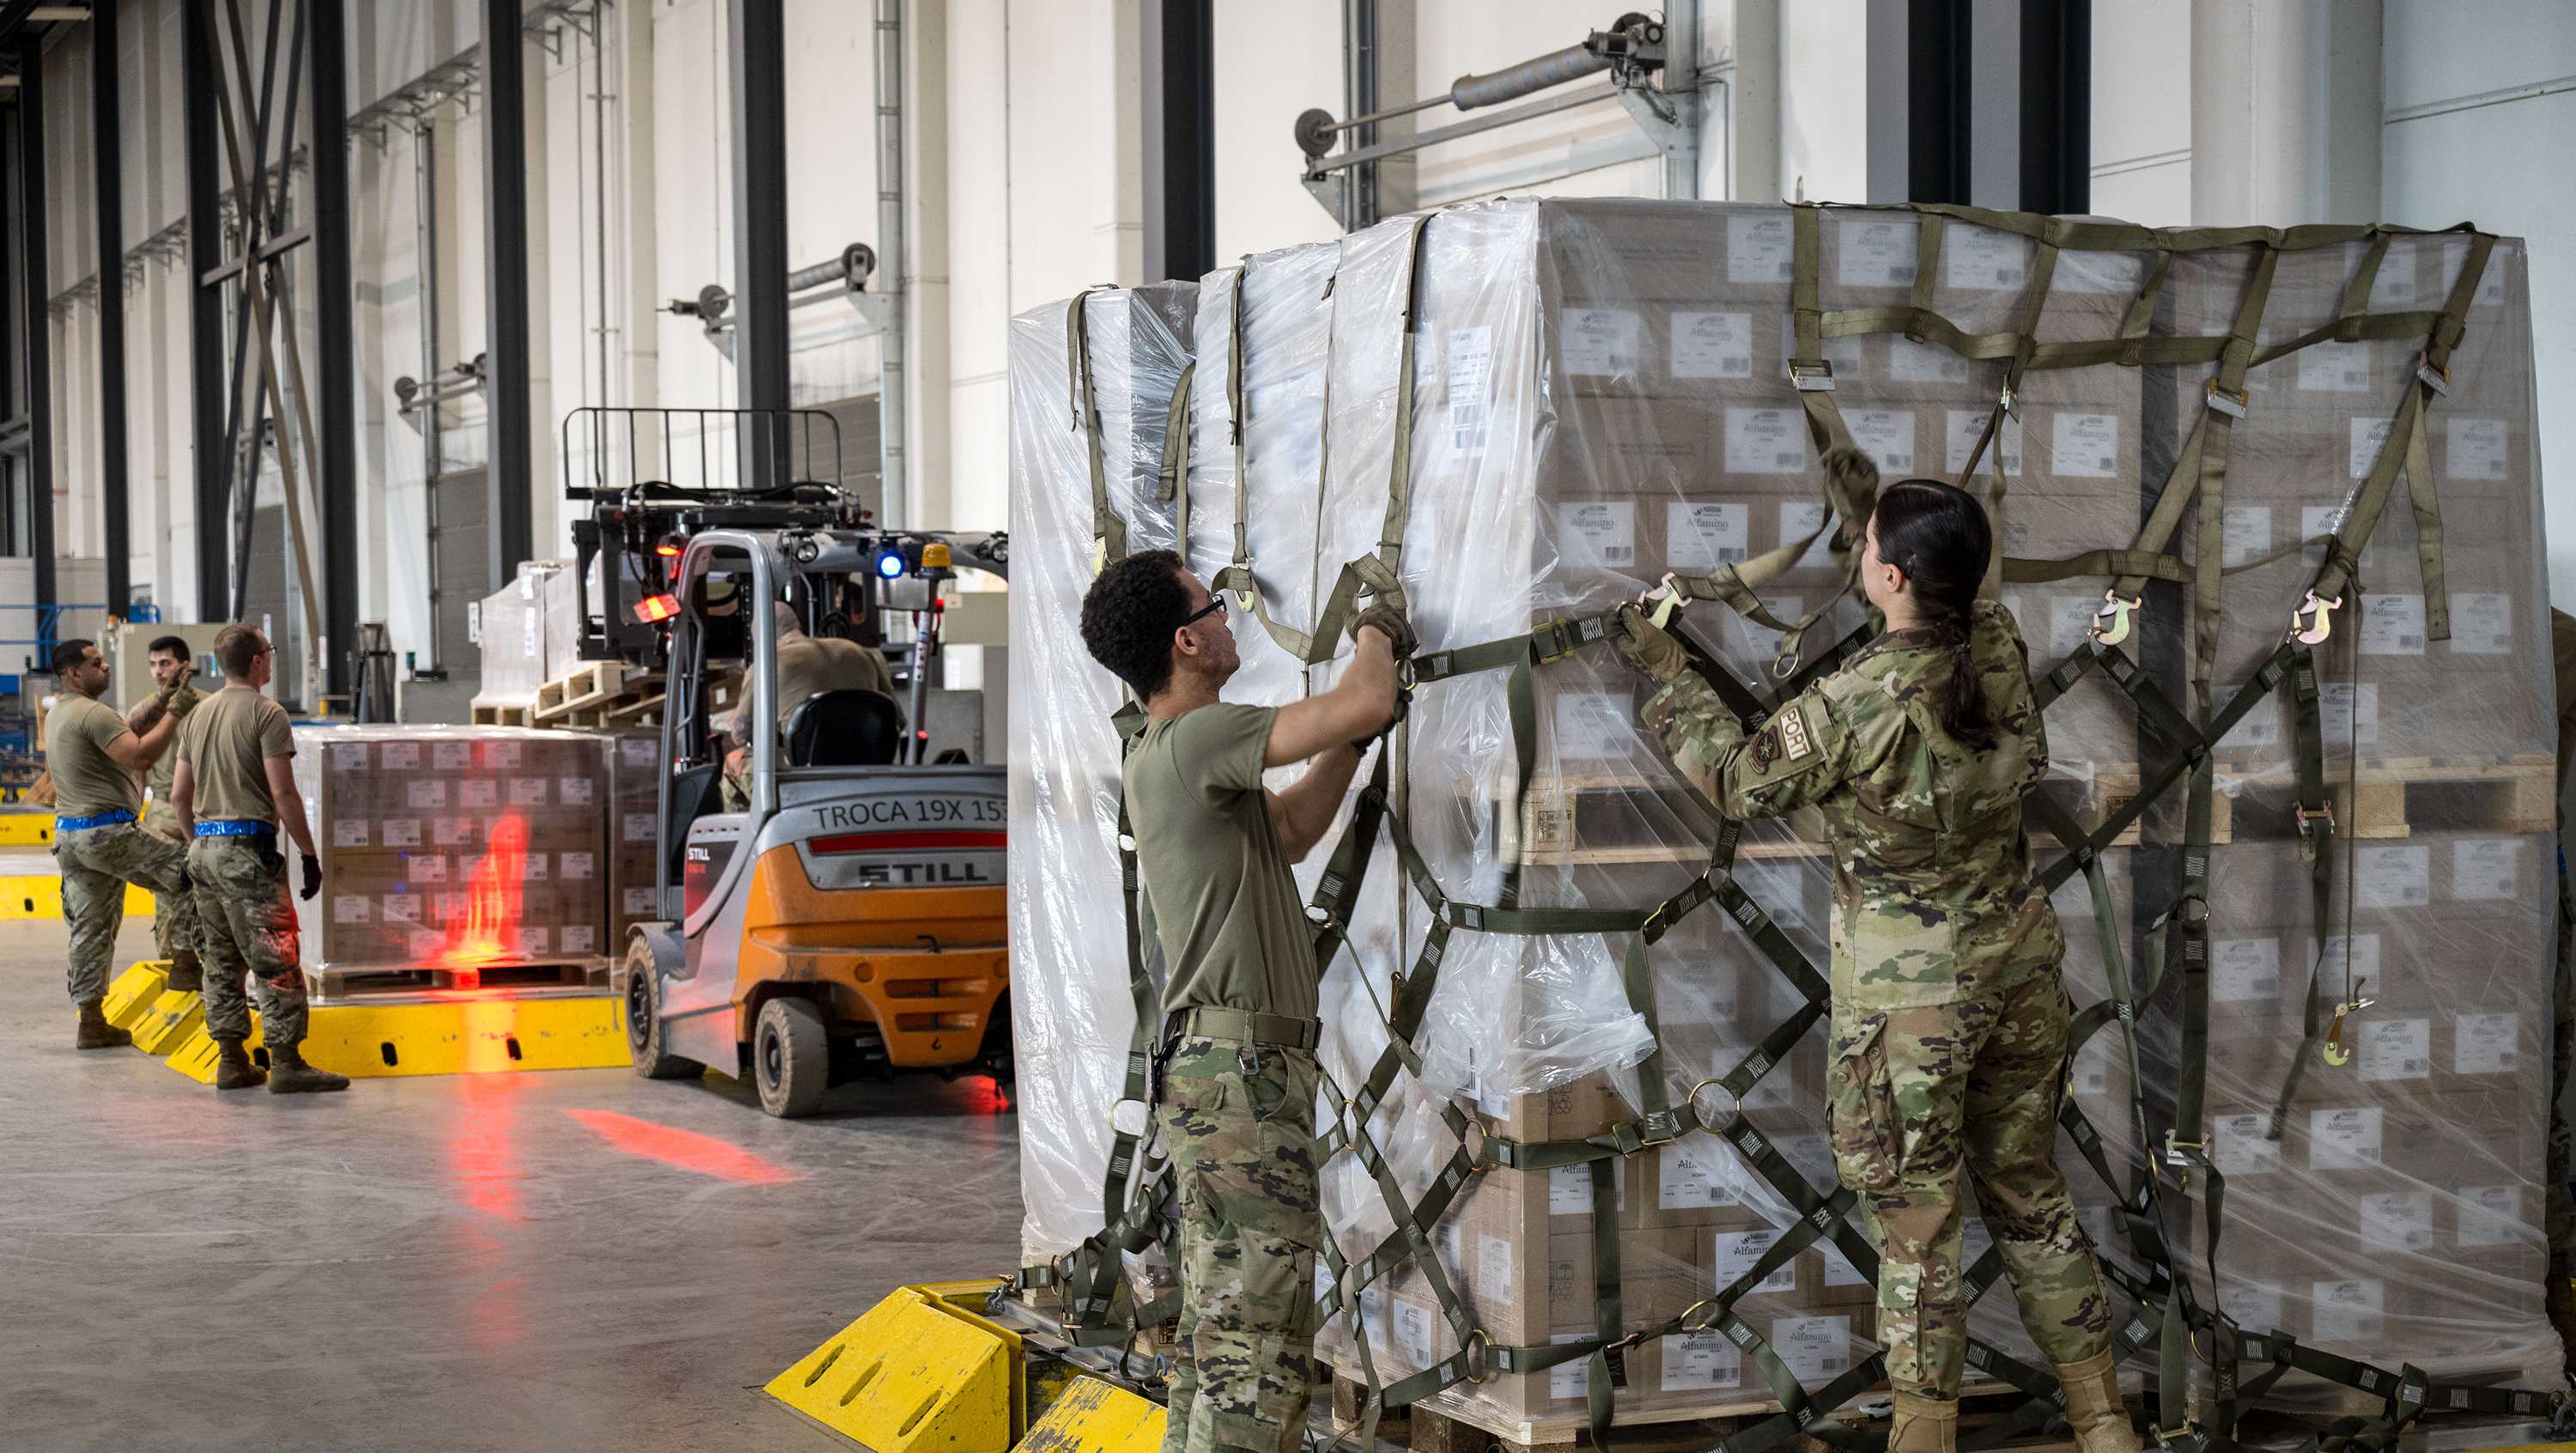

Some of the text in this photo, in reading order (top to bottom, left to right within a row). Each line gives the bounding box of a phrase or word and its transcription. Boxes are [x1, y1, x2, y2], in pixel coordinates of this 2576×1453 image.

[1782, 709, 1808, 756] PORT
[812, 799, 909, 830] TROCA
[915, 799, 964, 822] 19X
[688, 848, 711, 860] STILL
[860, 862, 987, 883] STILL
[1733, 1246, 1769, 1256] Alfami
